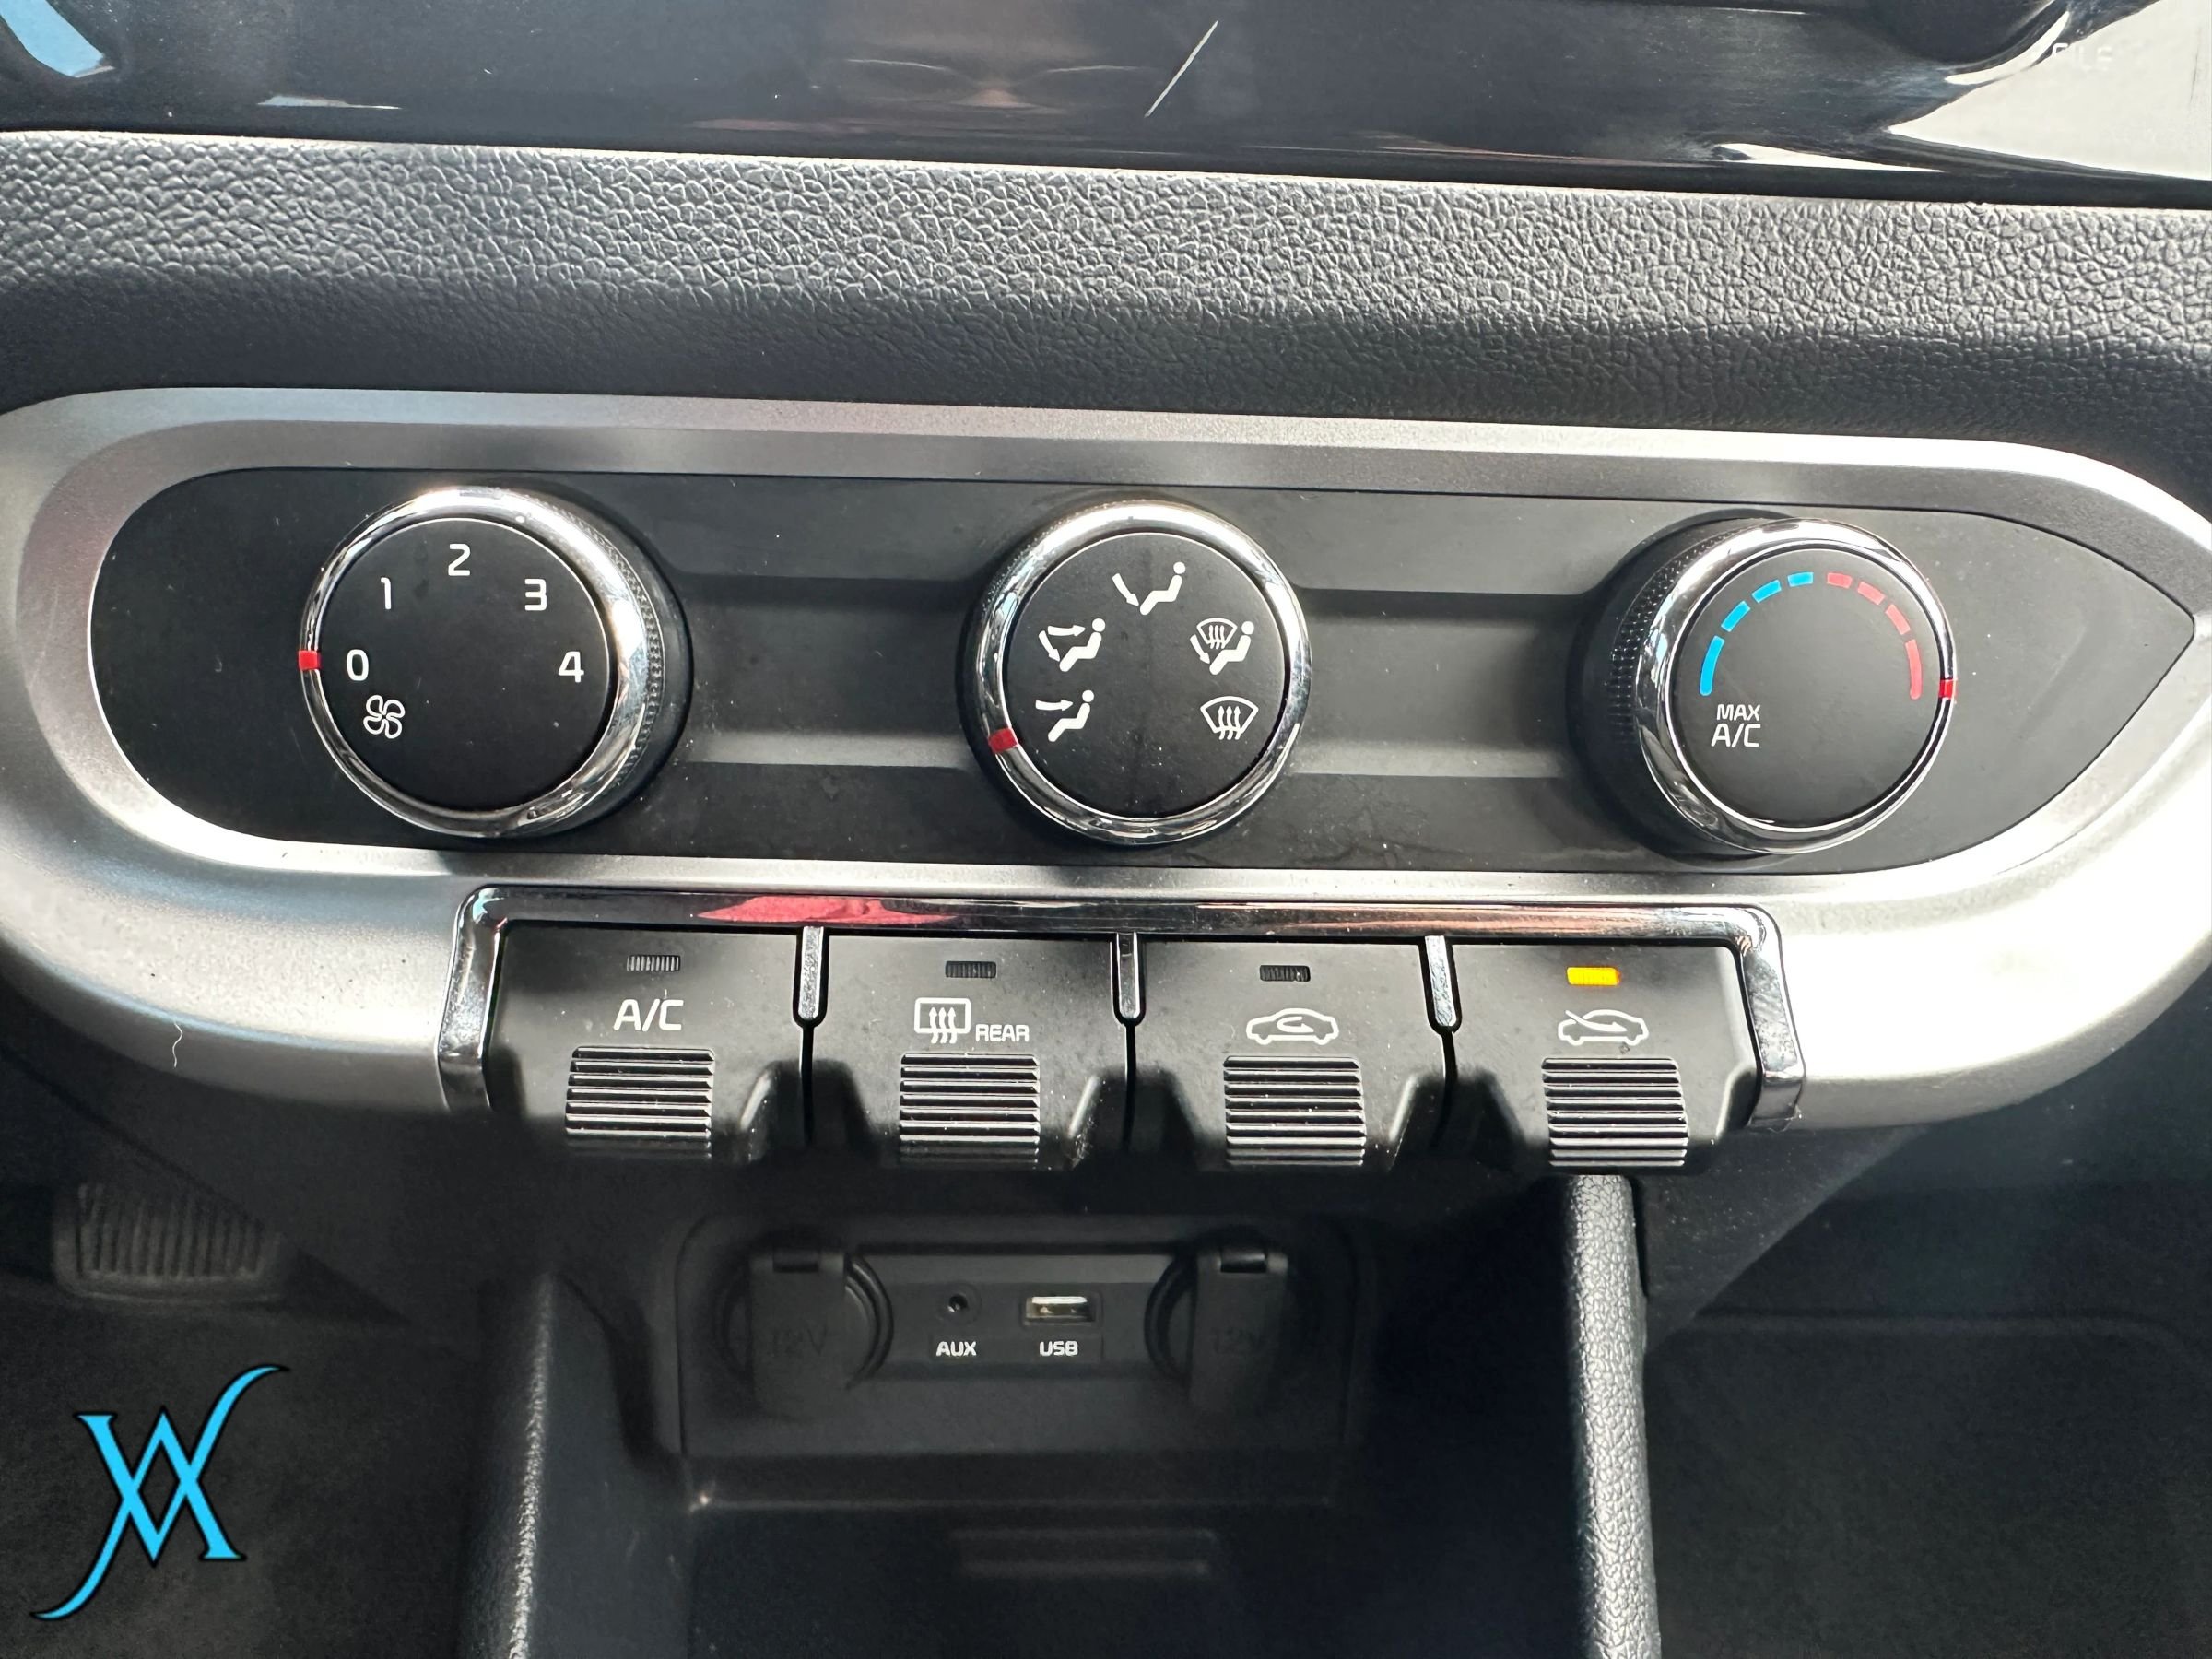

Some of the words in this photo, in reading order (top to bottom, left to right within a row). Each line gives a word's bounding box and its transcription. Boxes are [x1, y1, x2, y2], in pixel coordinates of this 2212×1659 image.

[447, 543, 471, 577] 2
[380, 577, 392, 610] 1
[524, 578, 547, 611] 3
[346, 649, 370, 682] 0
[558, 651, 585, 683] 4
[1716, 703, 1761, 722] MAX
[1711, 723, 1761, 748] A/C
[613, 998, 684, 1032] A/C
[975, 1023, 1030, 1042] REAR
[935, 1341, 977, 1357] AUX
[1039, 1340, 1078, 1357] USB
